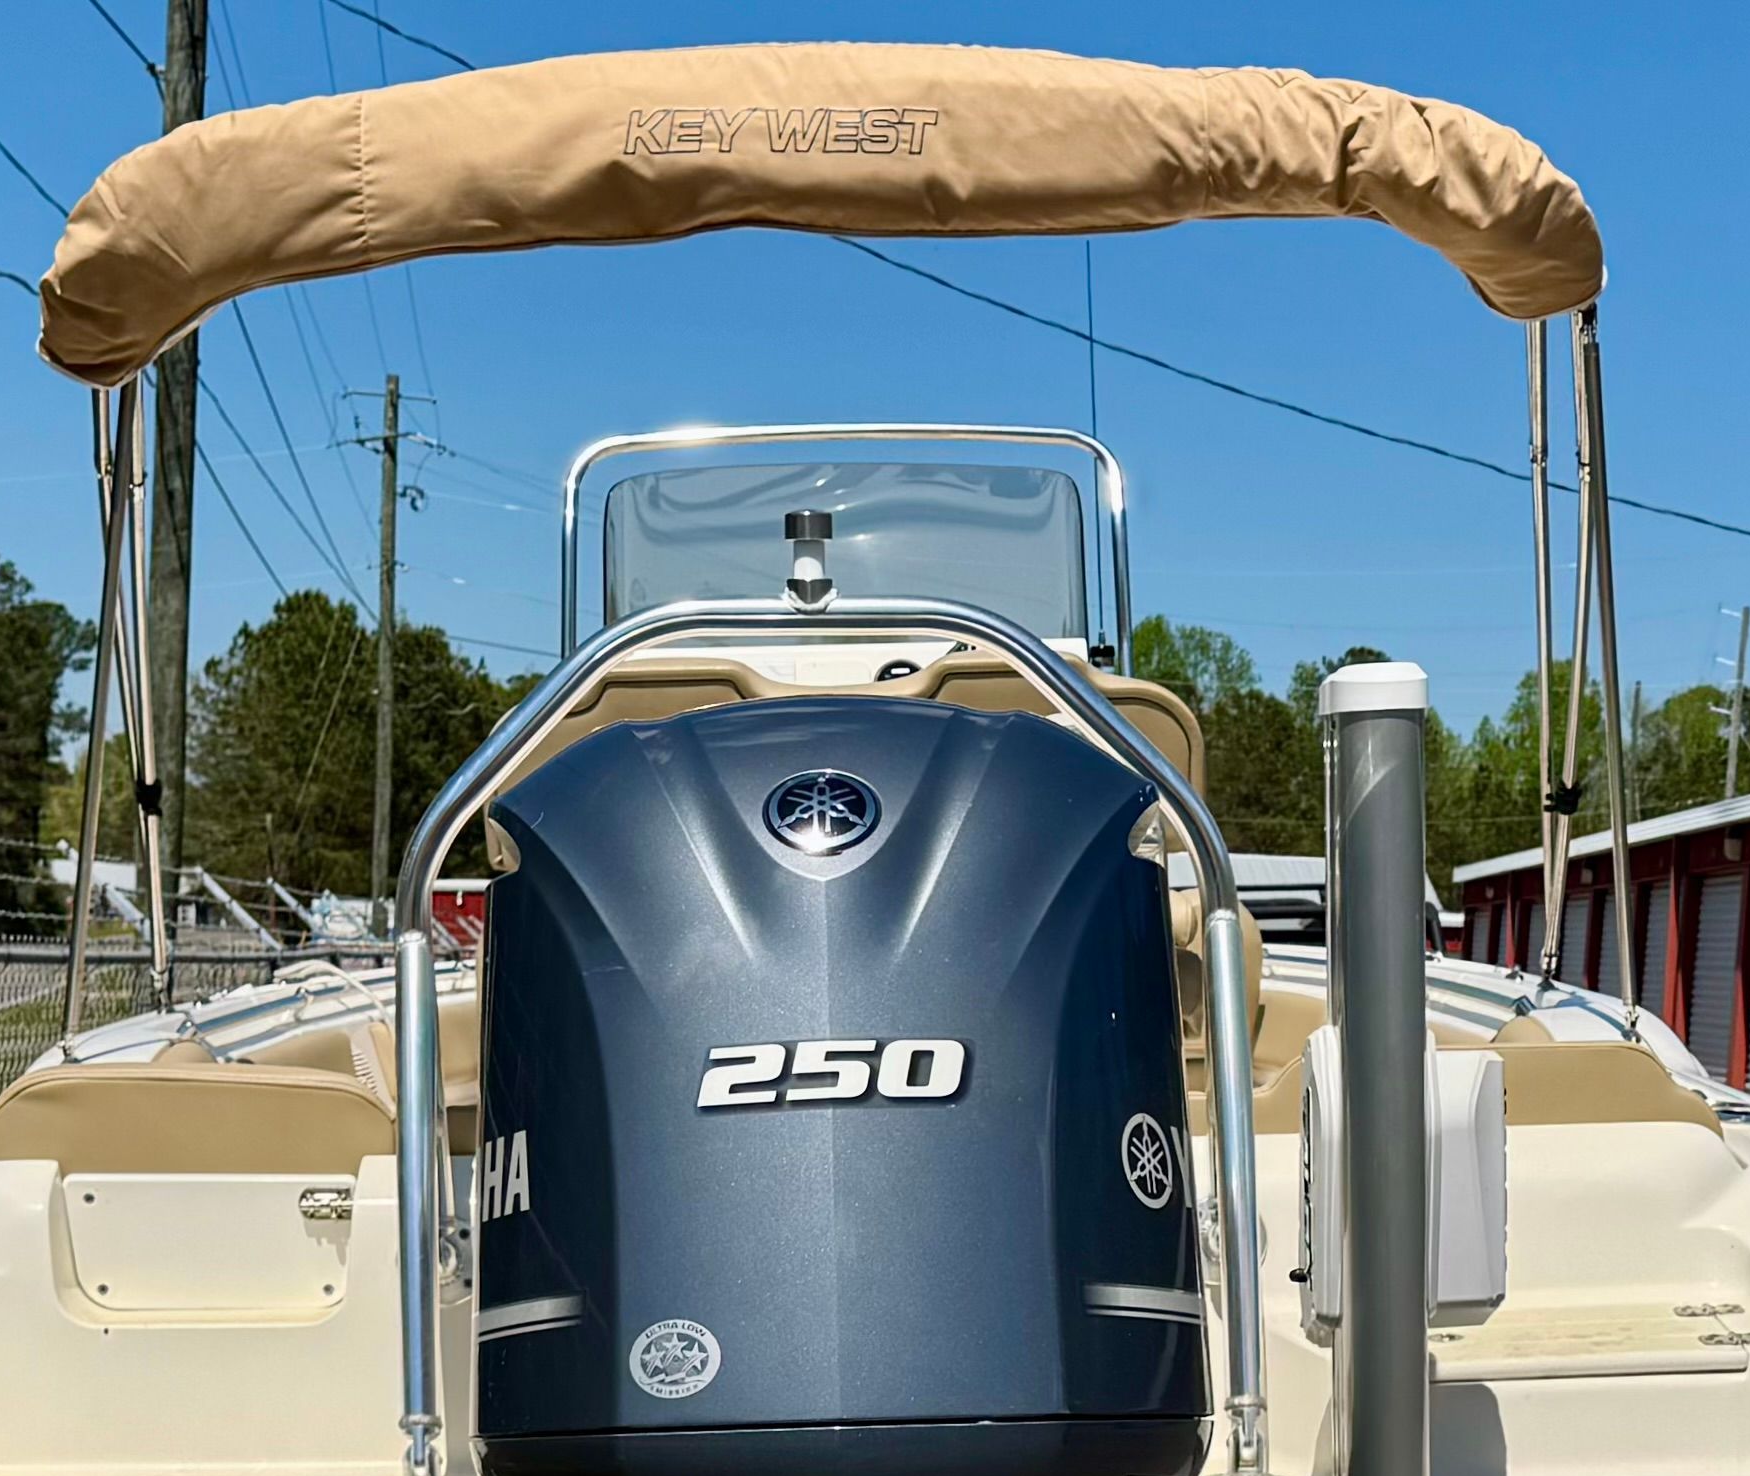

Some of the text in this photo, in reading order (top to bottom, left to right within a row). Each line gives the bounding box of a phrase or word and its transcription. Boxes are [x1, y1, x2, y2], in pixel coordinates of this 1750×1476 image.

[623, 107, 939, 155] KEY WEST
[697, 1039, 965, 1108] 250
[681, 1322, 706, 1337] LOW
